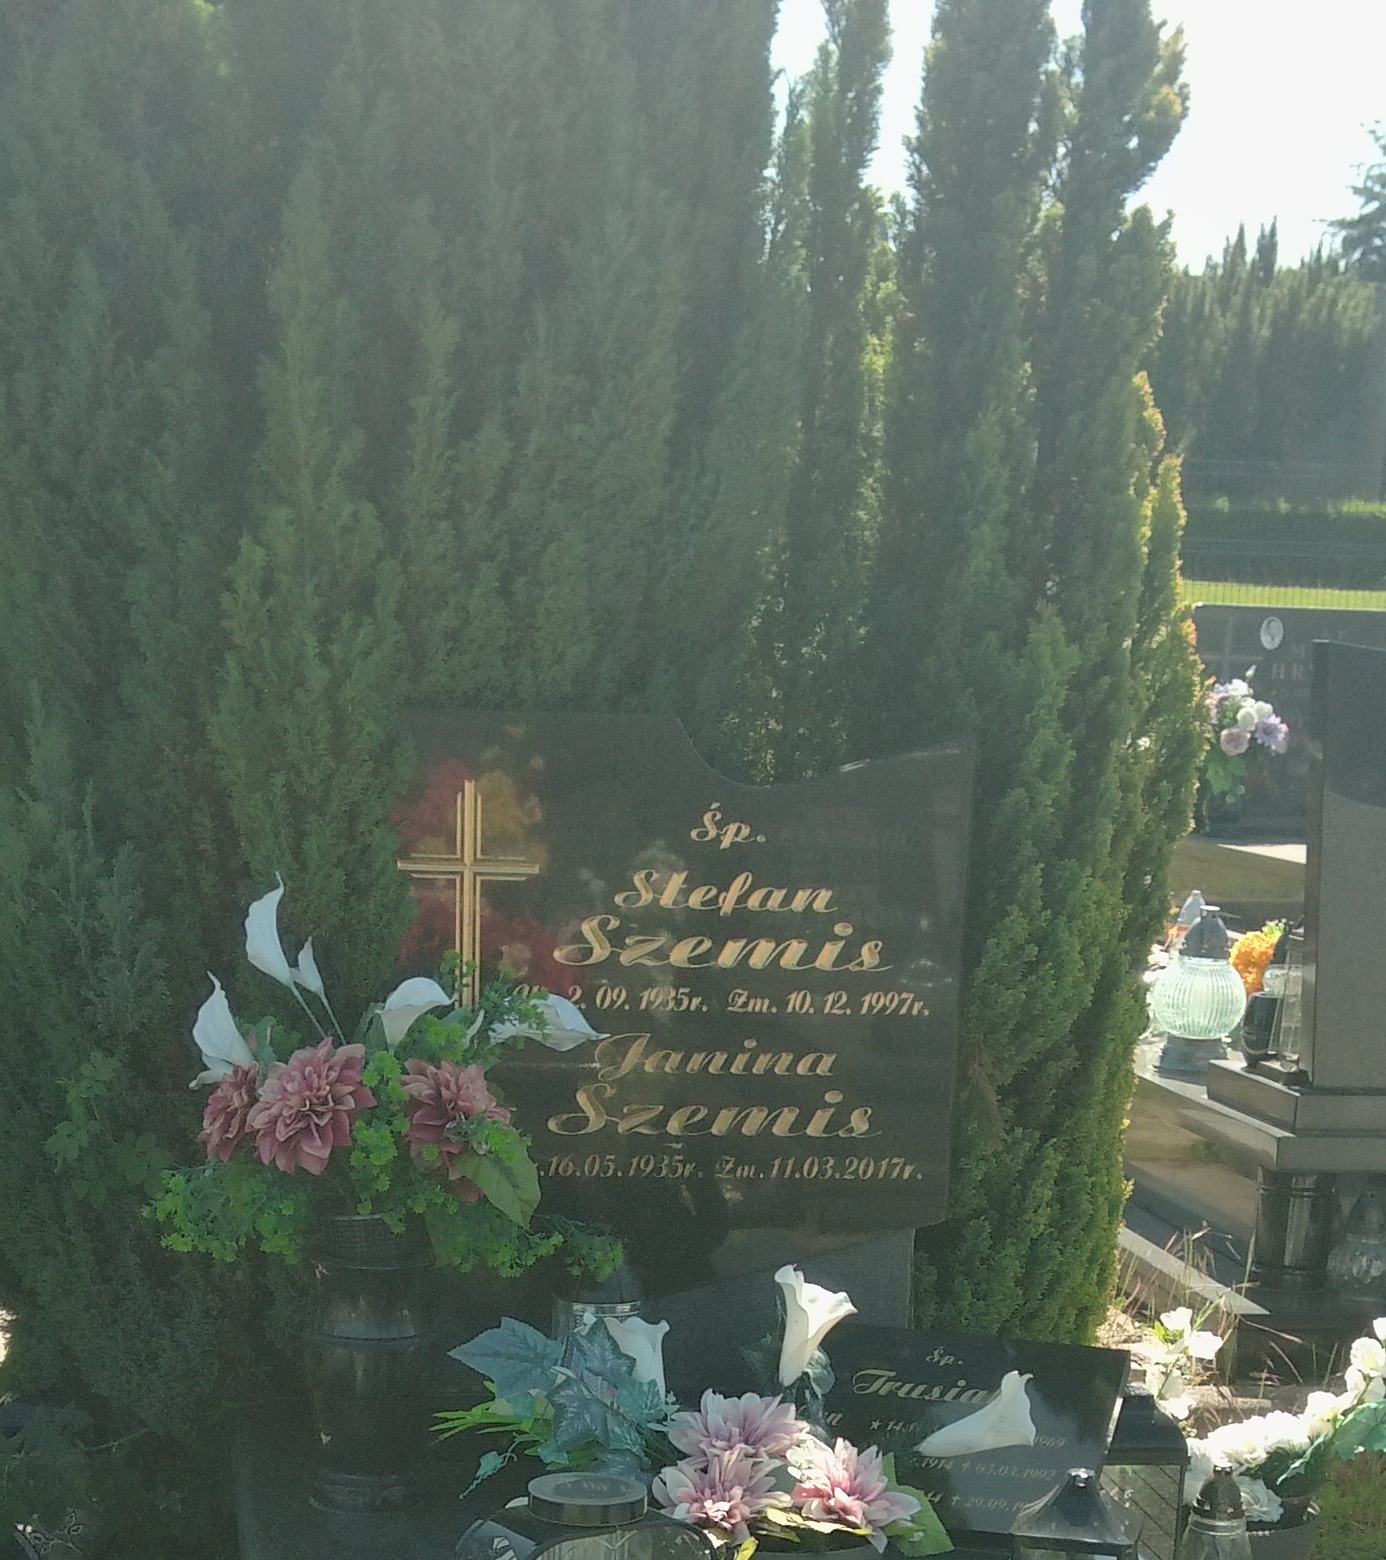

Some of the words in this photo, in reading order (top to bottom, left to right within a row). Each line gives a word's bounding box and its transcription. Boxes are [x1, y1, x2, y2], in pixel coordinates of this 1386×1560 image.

[690, 802, 766, 849] Śp.
[614, 869, 838, 917] Stefan
[553, 914, 893, 971] Szemis
[639, 986, 708, 1012] 1935r.
[726, 989, 778, 1014] Zm.
[860, 991, 930, 1017] 1997r.
[594, 1033, 838, 1081] Janina
[547, 1083, 883, 1138] Szemis
[852, 1368, 1002, 1404] Trusia
